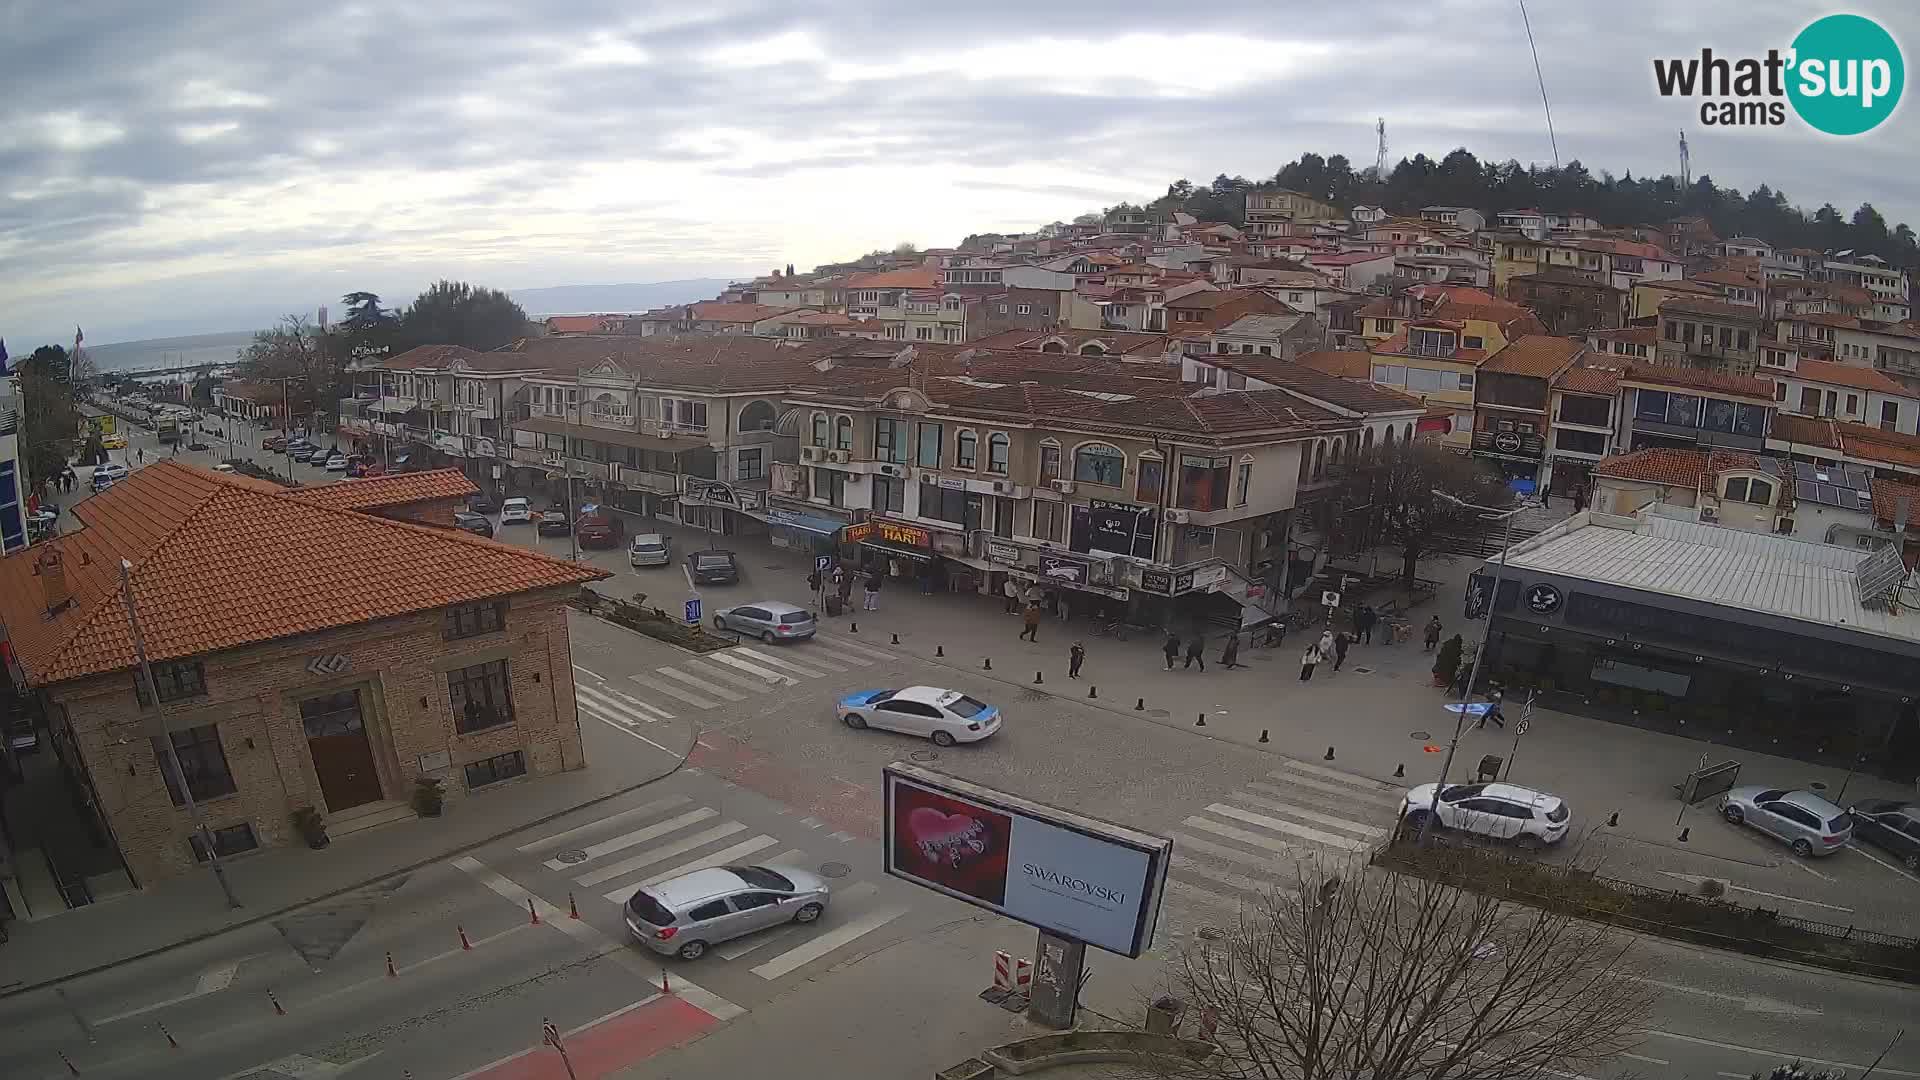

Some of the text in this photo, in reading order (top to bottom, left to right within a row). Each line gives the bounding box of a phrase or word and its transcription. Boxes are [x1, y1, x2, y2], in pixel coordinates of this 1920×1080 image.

[851, 527, 871, 537] HARI
[884, 529, 915, 544] HARI
[819, 558, 828, 569] P
[1023, 863, 1125, 905] SWAROVSKI
